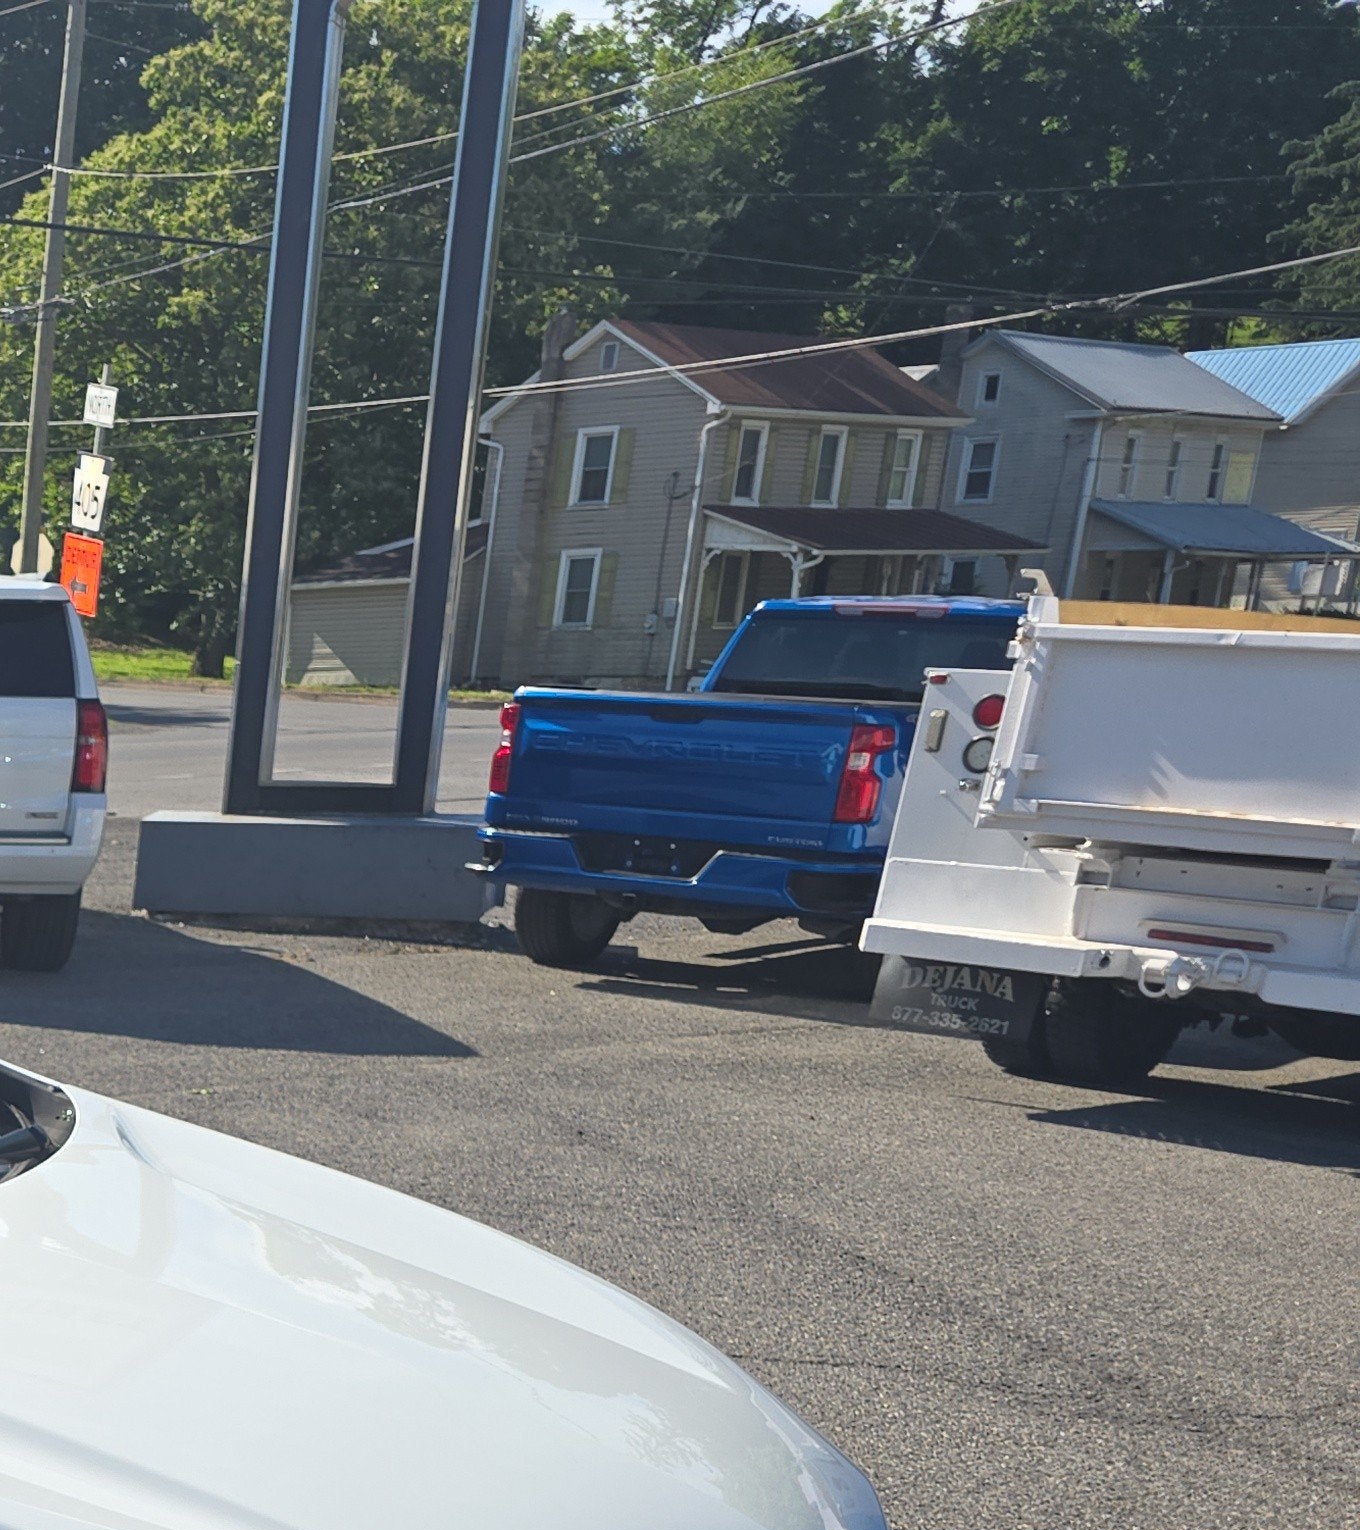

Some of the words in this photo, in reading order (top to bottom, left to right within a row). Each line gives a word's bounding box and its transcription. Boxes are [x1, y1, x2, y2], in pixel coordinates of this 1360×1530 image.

[900, 965, 1015, 1002] DEJANA
[930, 993, 980, 1011] TRUCK
[891, 1005, 1010, 1035] 877-335-2621
